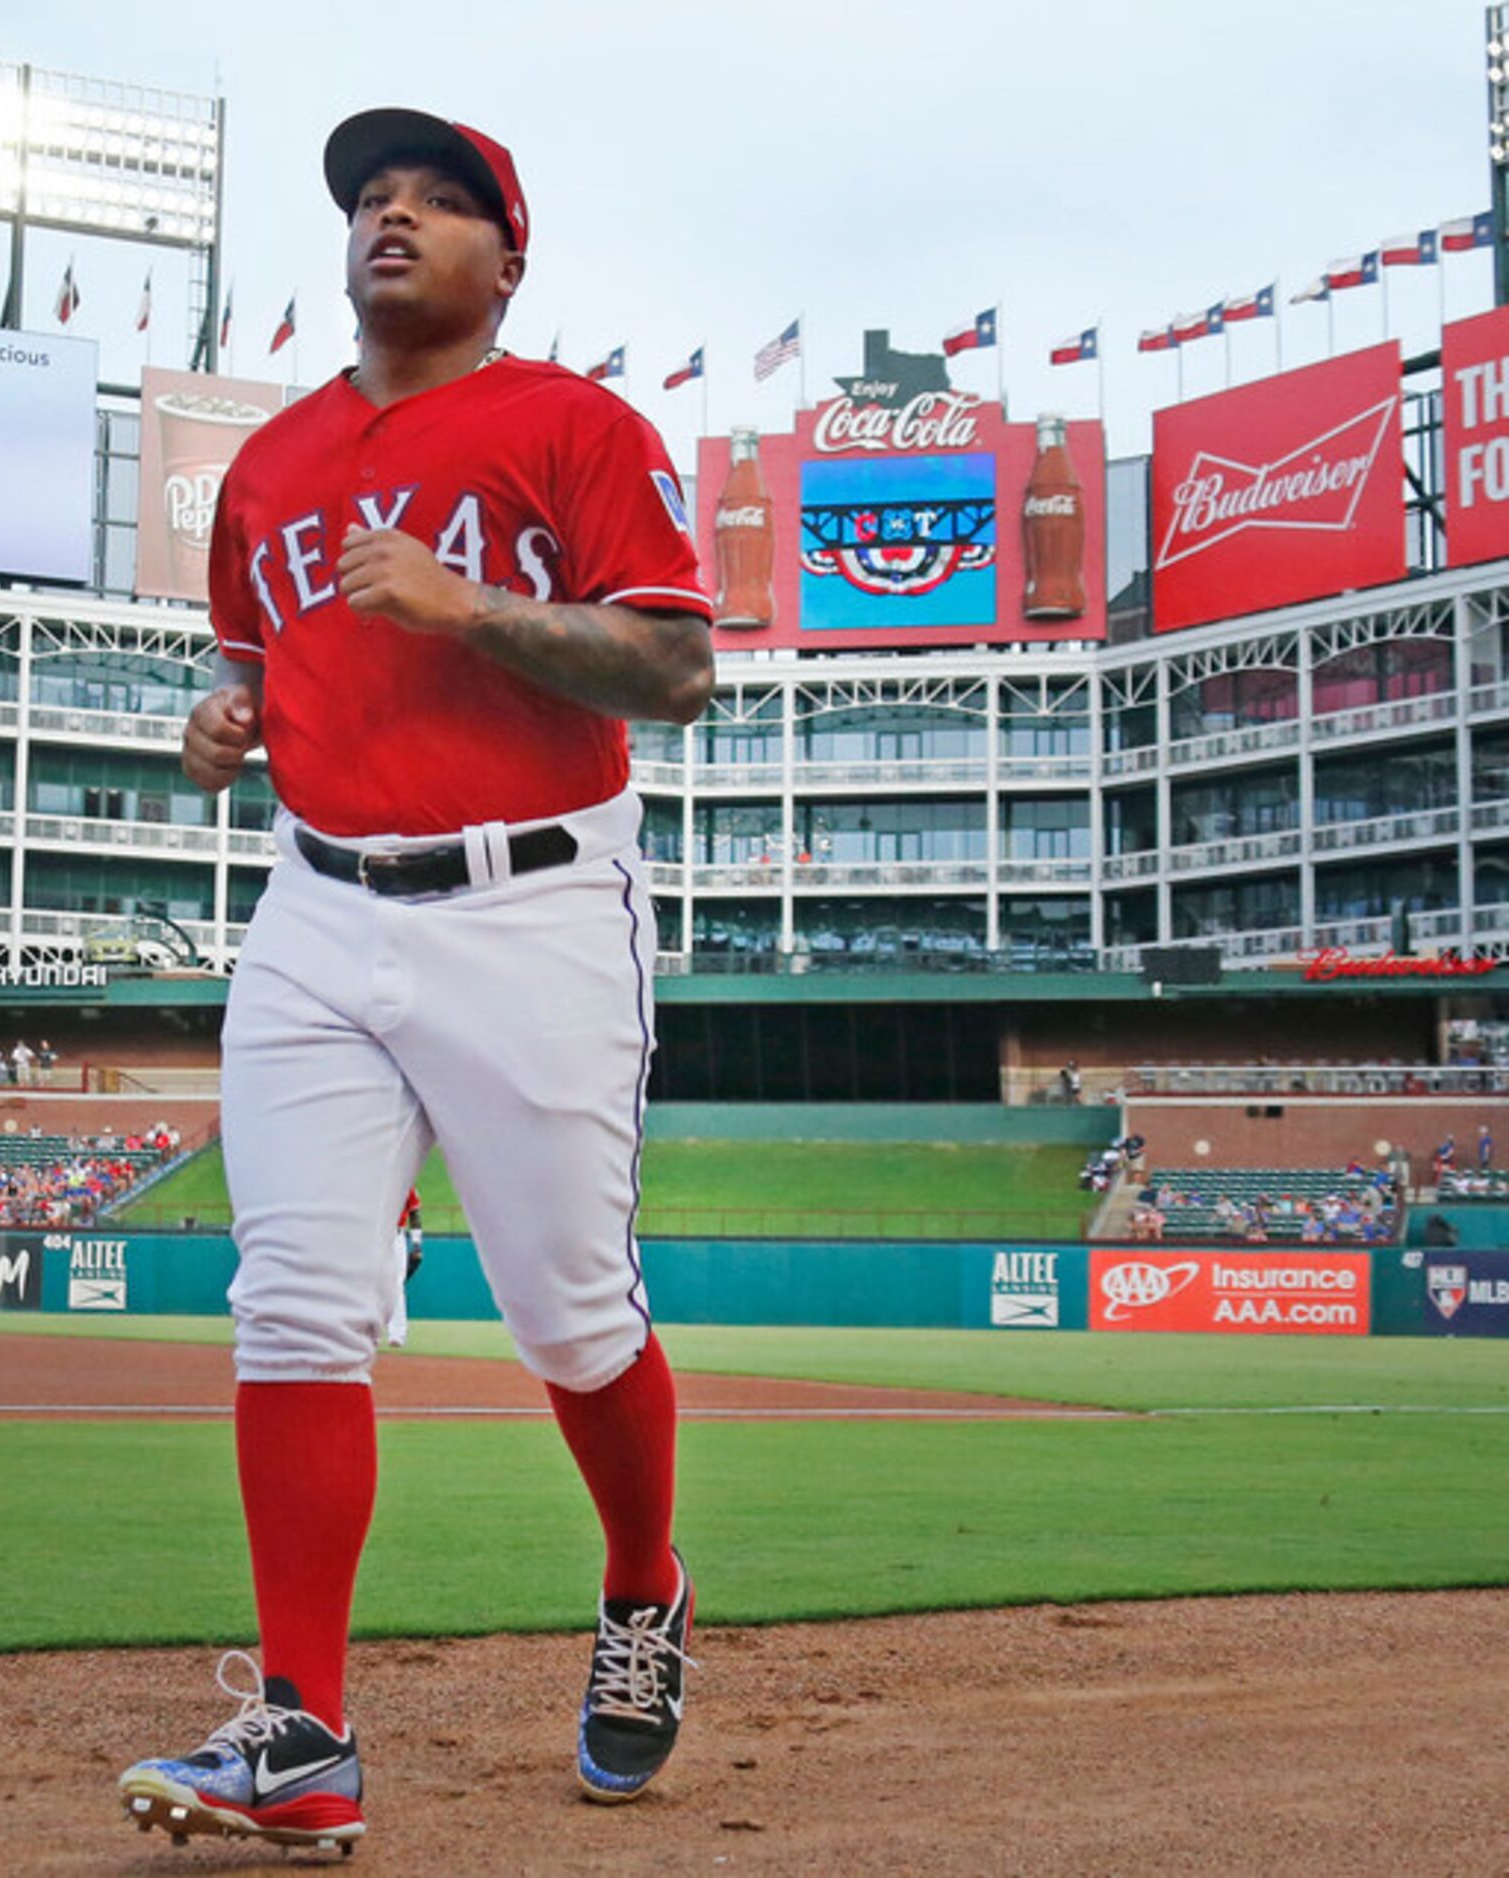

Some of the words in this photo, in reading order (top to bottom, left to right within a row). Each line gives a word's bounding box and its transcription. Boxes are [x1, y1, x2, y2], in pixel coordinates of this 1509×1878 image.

[851, 379, 898, 401] Enjoy
[1454, 356, 1509, 430] TH
[1173, 454, 1375, 534] Budweiser
[914, 511, 938, 537] T
[70, 1240, 127, 1269] ALTEC
[992, 1252, 1058, 1284] ALTEC
[1105, 1264, 1167, 1304] AAA
[1212, 1263, 1356, 1291] Insurance
[1213, 1299, 1356, 1325] AAA.com
